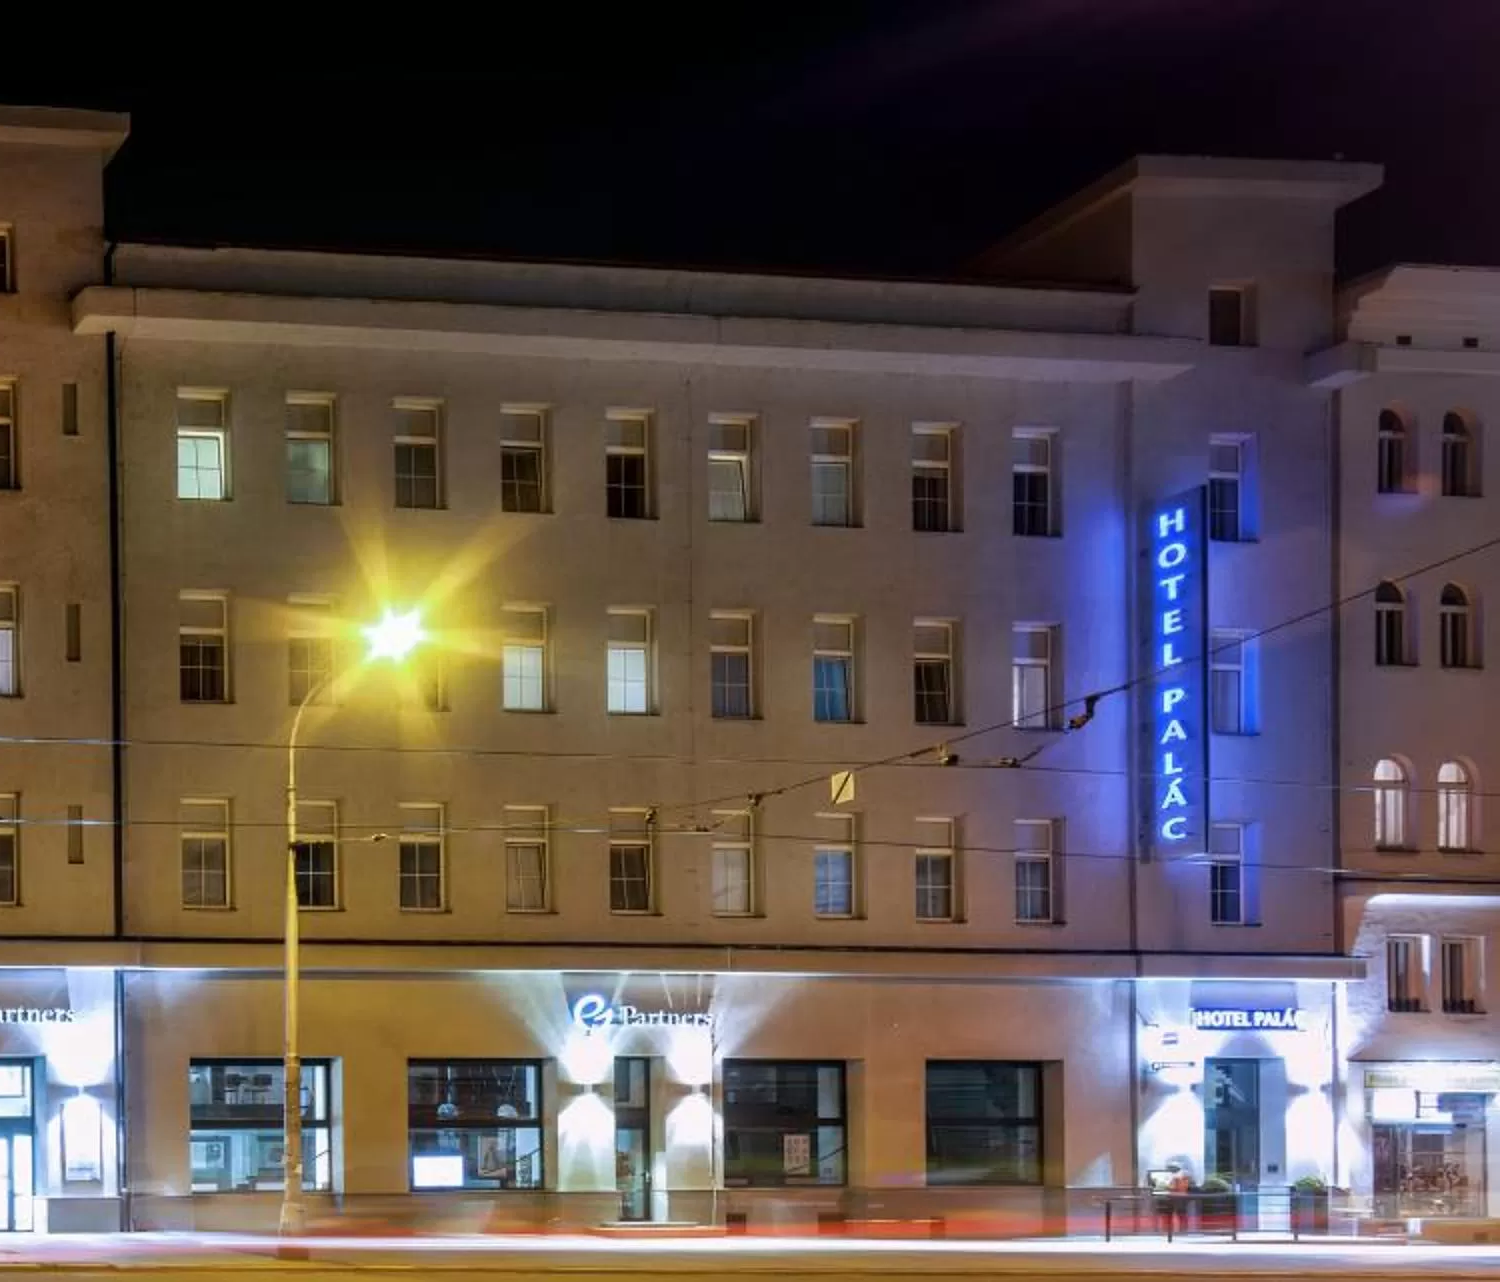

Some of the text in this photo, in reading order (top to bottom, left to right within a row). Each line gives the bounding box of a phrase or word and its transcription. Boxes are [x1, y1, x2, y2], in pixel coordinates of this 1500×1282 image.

[1158, 508, 1188, 841] HOTEL PALÁC
[620, 1005, 714, 1026] Partners
[1197, 1009, 1250, 1027] HOTEL
